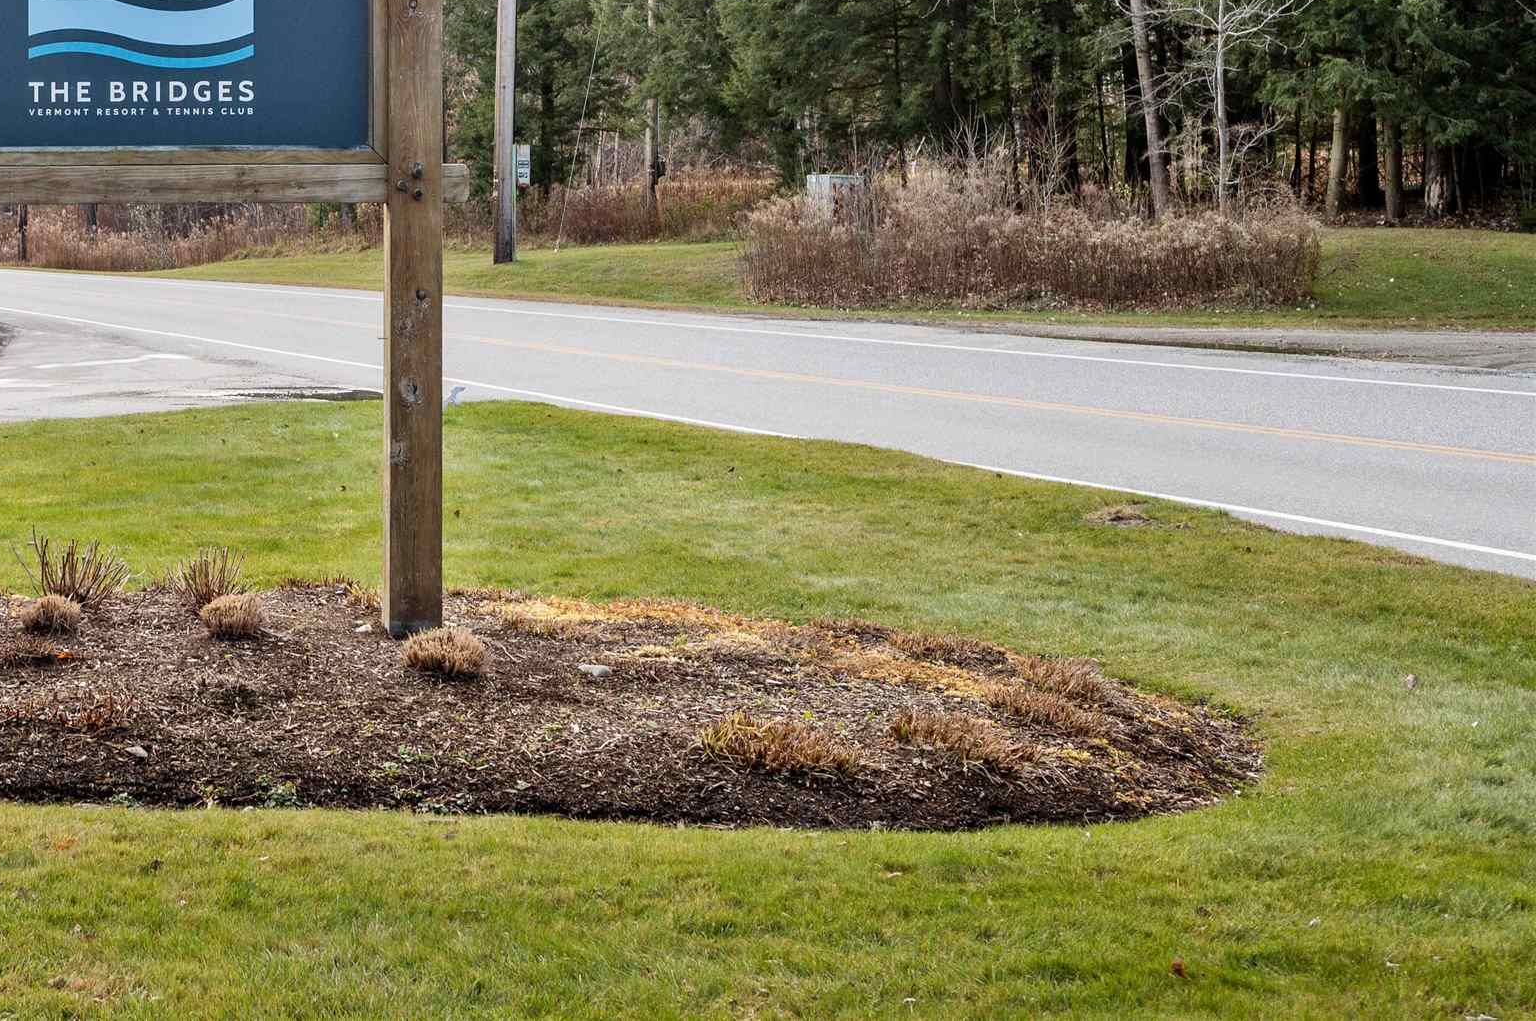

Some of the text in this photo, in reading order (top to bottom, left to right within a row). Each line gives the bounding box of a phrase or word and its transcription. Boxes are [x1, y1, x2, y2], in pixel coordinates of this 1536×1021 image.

[27, 80, 256, 103] THE BRIDGES
[28, 107, 254, 117] VERMONT RESORT & TENNIS CLUB
